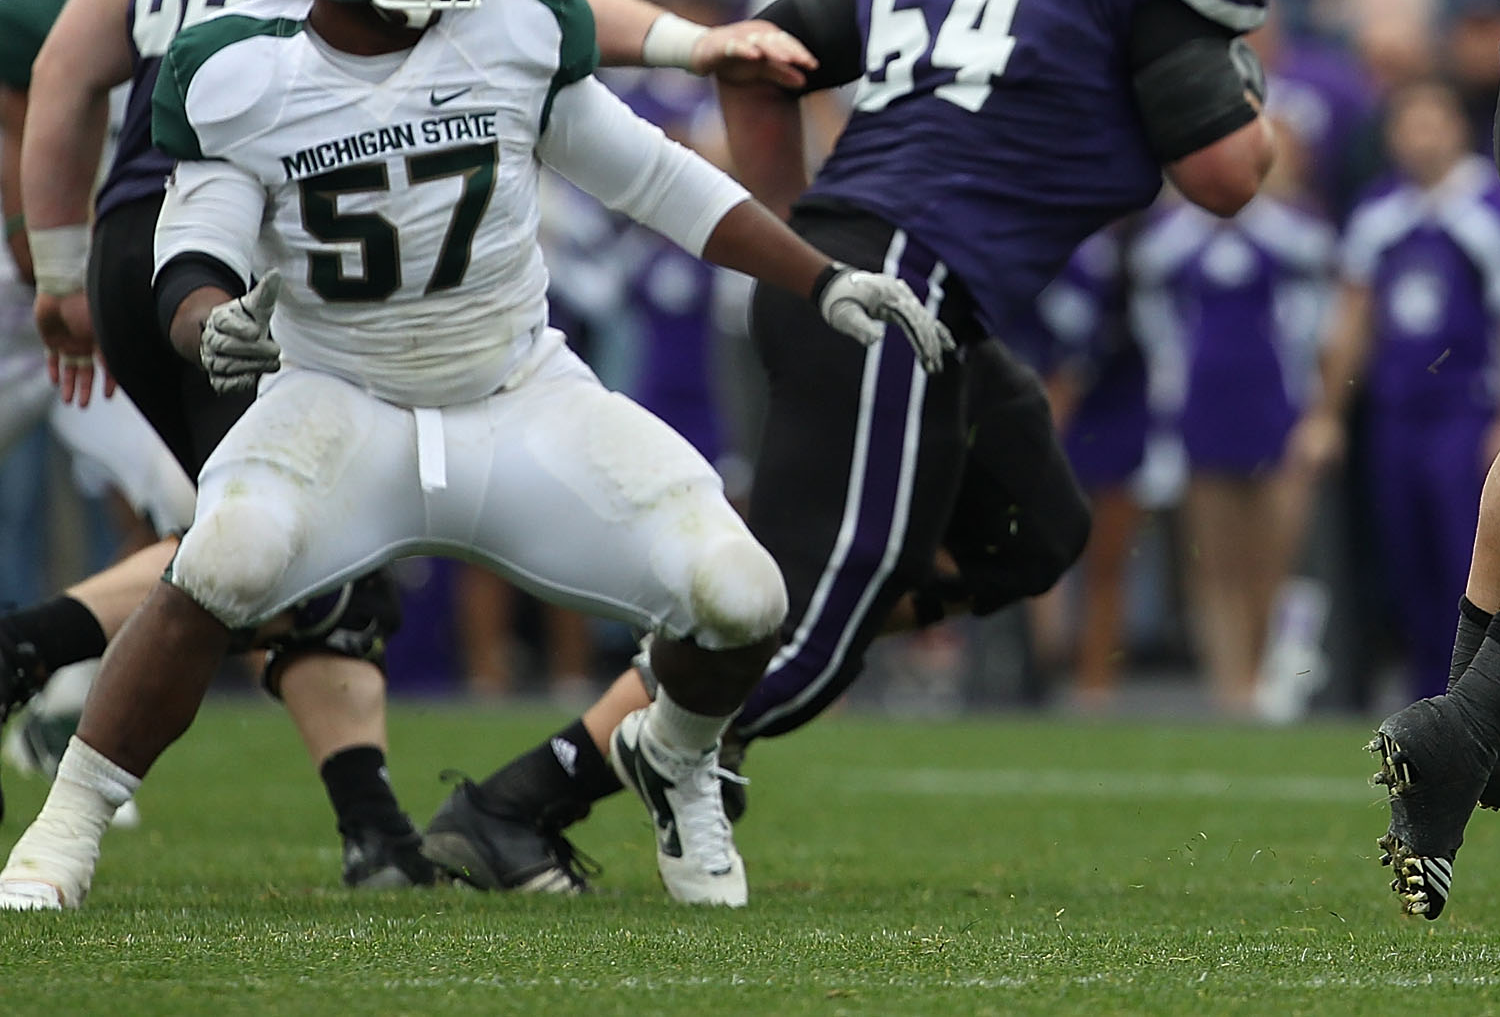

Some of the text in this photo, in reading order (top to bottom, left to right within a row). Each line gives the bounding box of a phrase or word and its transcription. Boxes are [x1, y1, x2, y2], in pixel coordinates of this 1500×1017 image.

[281, 111, 497, 180] MICHIGAN STATE
[299, 141, 499, 303] 57
